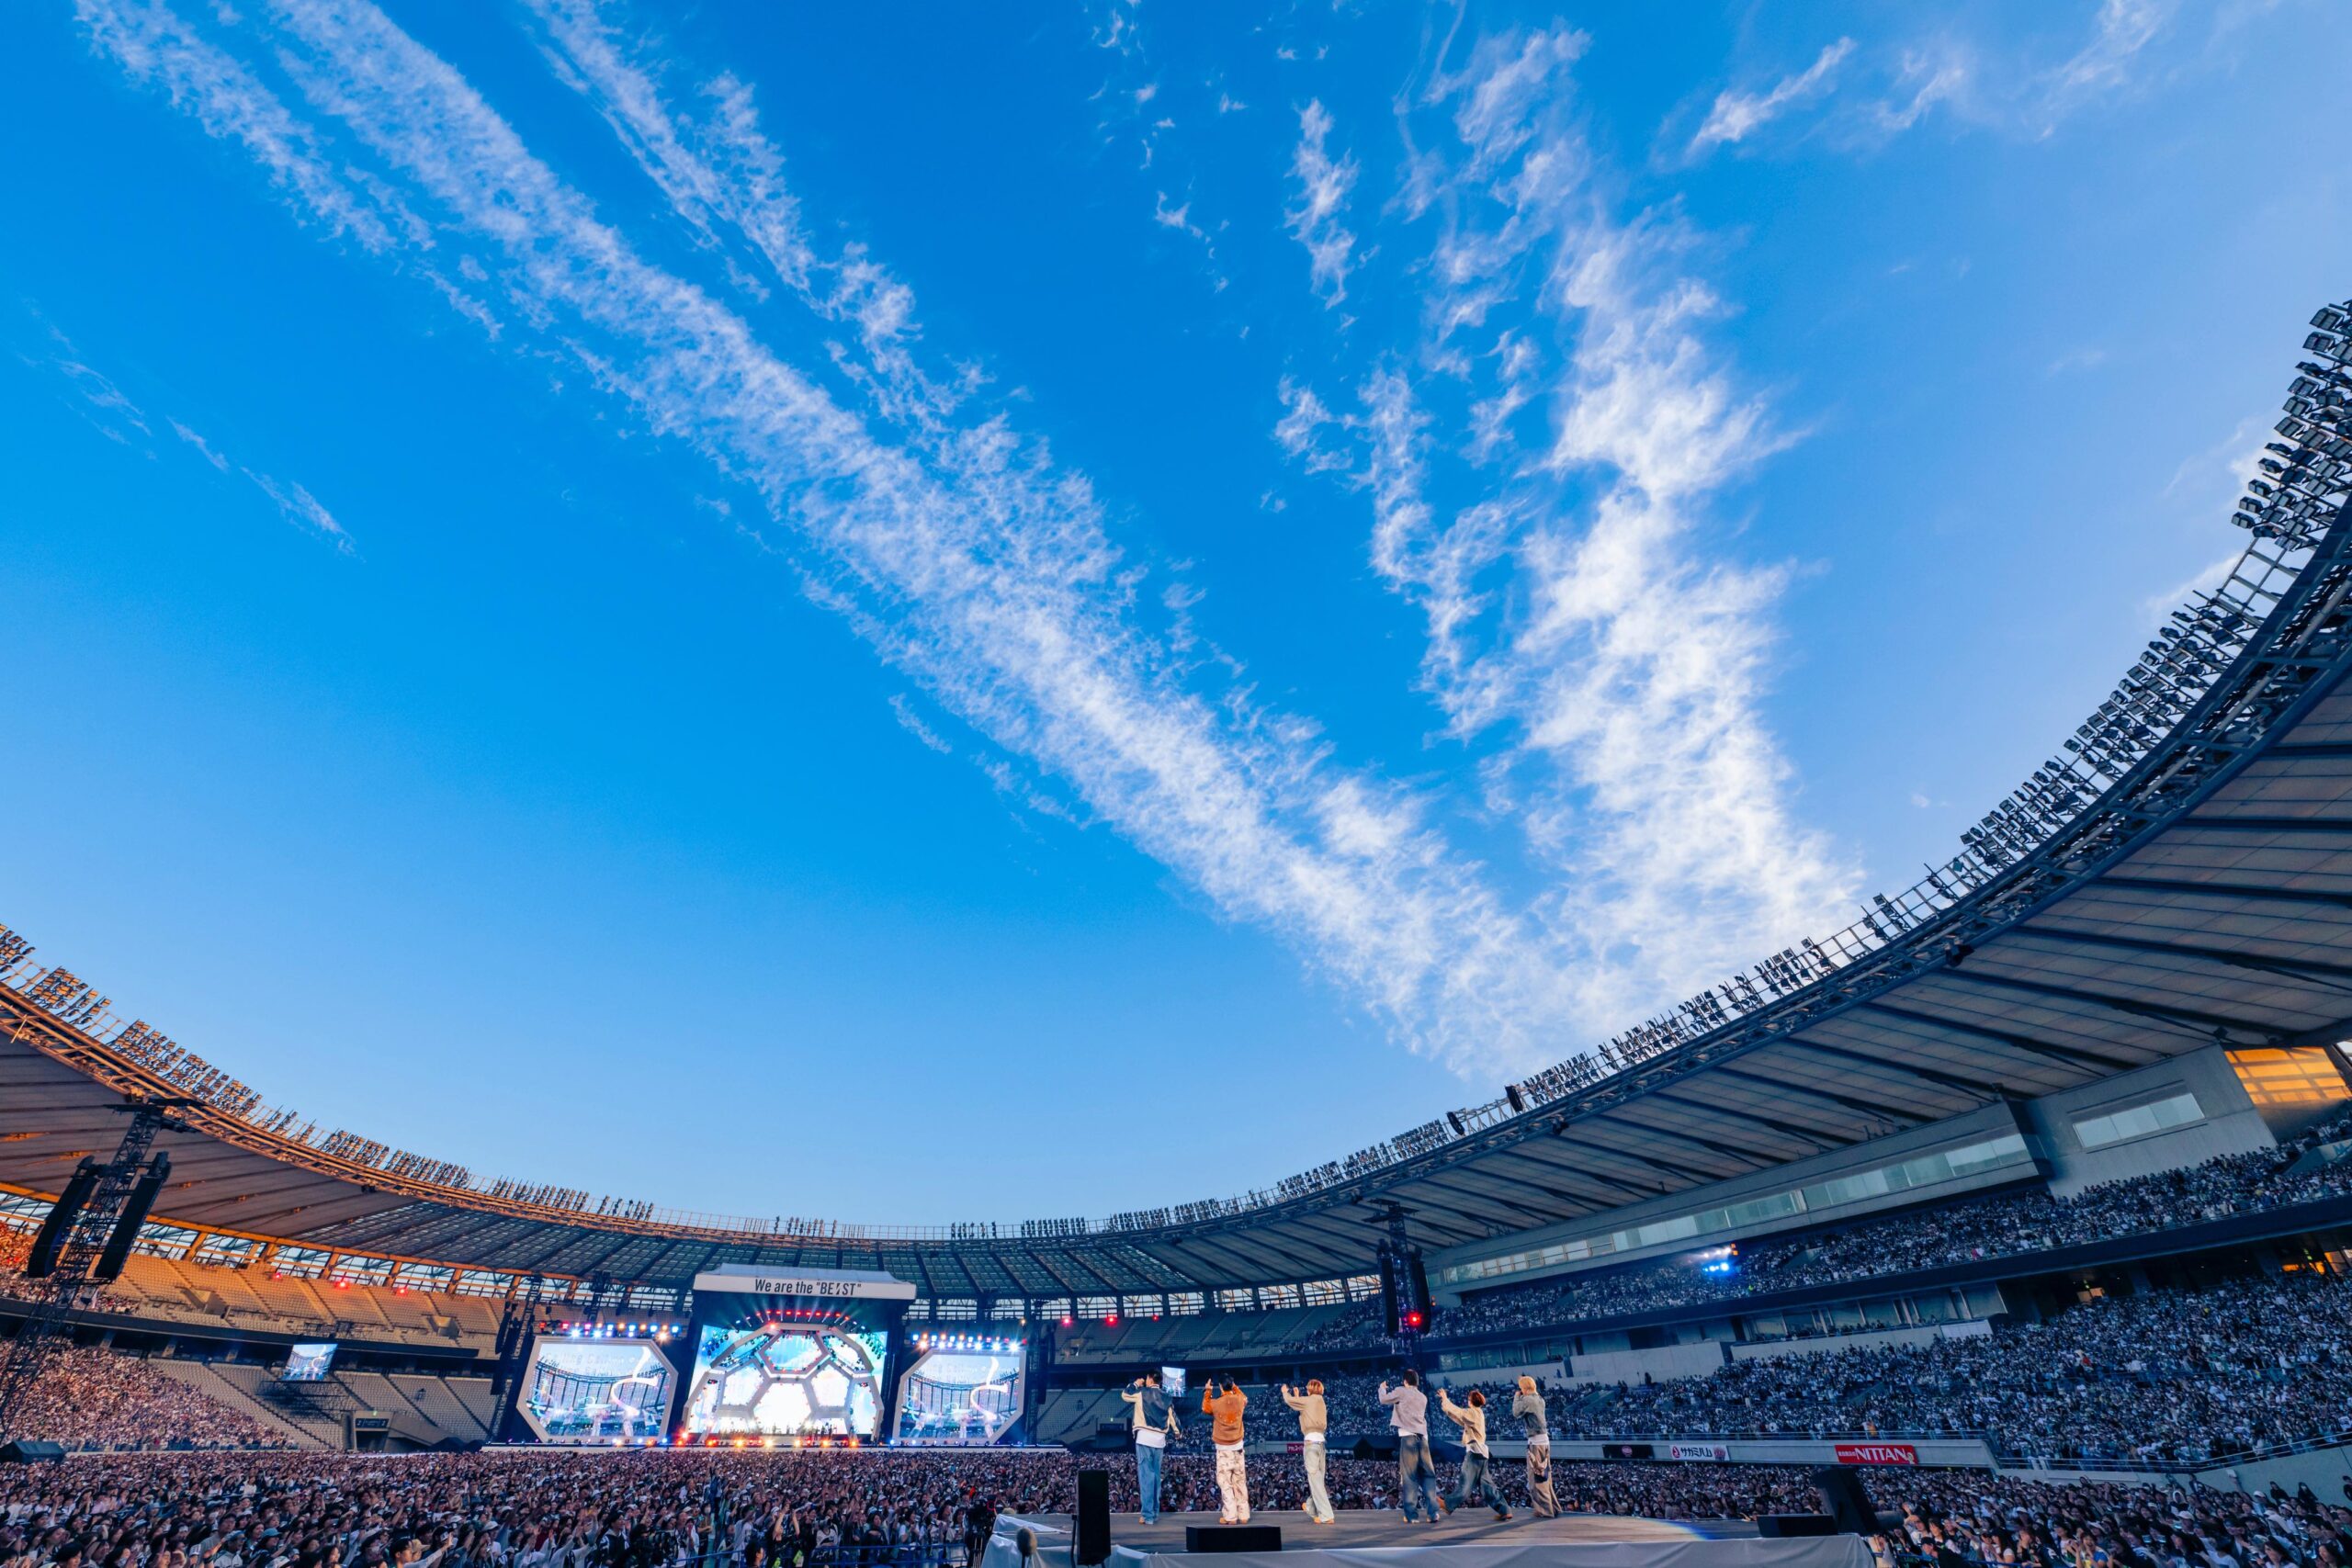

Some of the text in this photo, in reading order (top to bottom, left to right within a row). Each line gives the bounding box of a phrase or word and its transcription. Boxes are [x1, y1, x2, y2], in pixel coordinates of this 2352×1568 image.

[755, 1279, 772, 1292] We
[774, 1281, 793, 1293] are
[796, 1281, 813, 1294] the
[1854, 1448, 1909, 1461] NITTAN
